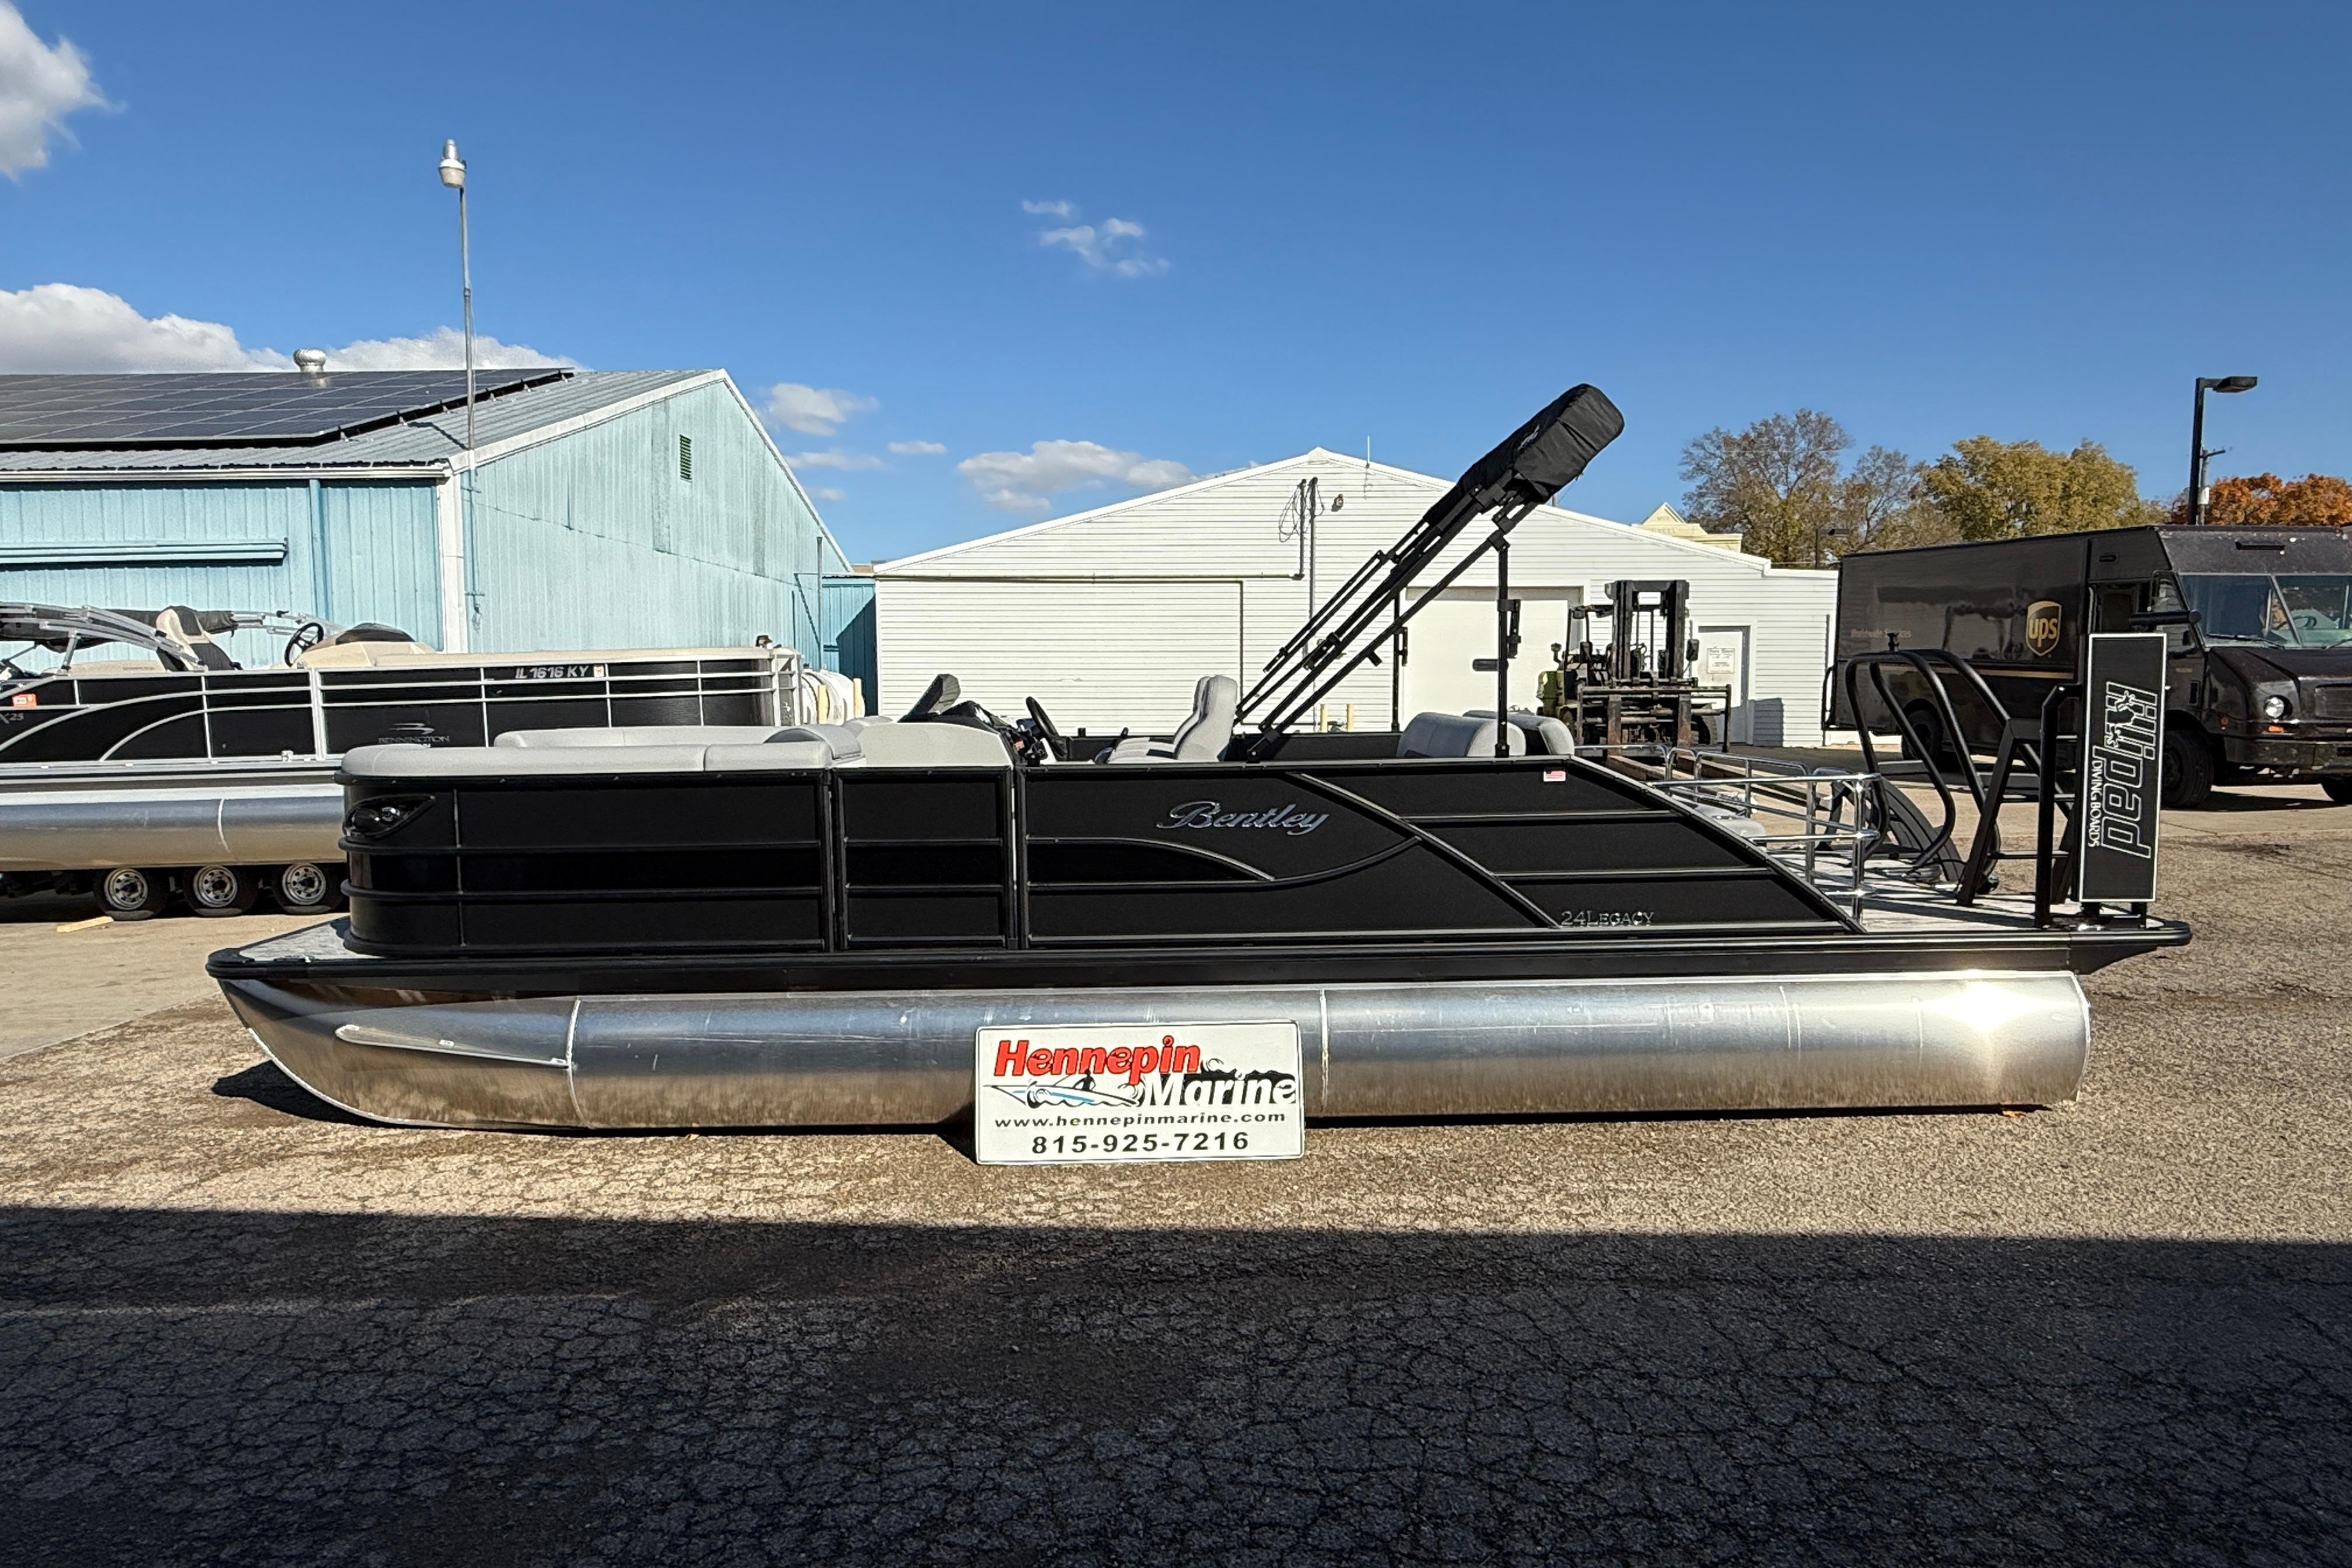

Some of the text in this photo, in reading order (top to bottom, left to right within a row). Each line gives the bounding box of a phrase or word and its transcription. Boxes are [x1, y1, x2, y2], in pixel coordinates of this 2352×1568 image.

[2029, 618, 2057, 647] ups
[514, 667, 527, 679] IL
[567, 665, 589, 677] KY
[1156, 800, 1330, 835] Bentley
[2088, 760, 2103, 847] DIVING BOARDS
[993, 1035, 1201, 1085] Hennepin
[1146, 1072, 1297, 1107] Marine
[994, 1112, 1286, 1128] www.hennepinmarine.com
[1031, 1132, 1250, 1154] 815-925-7216
